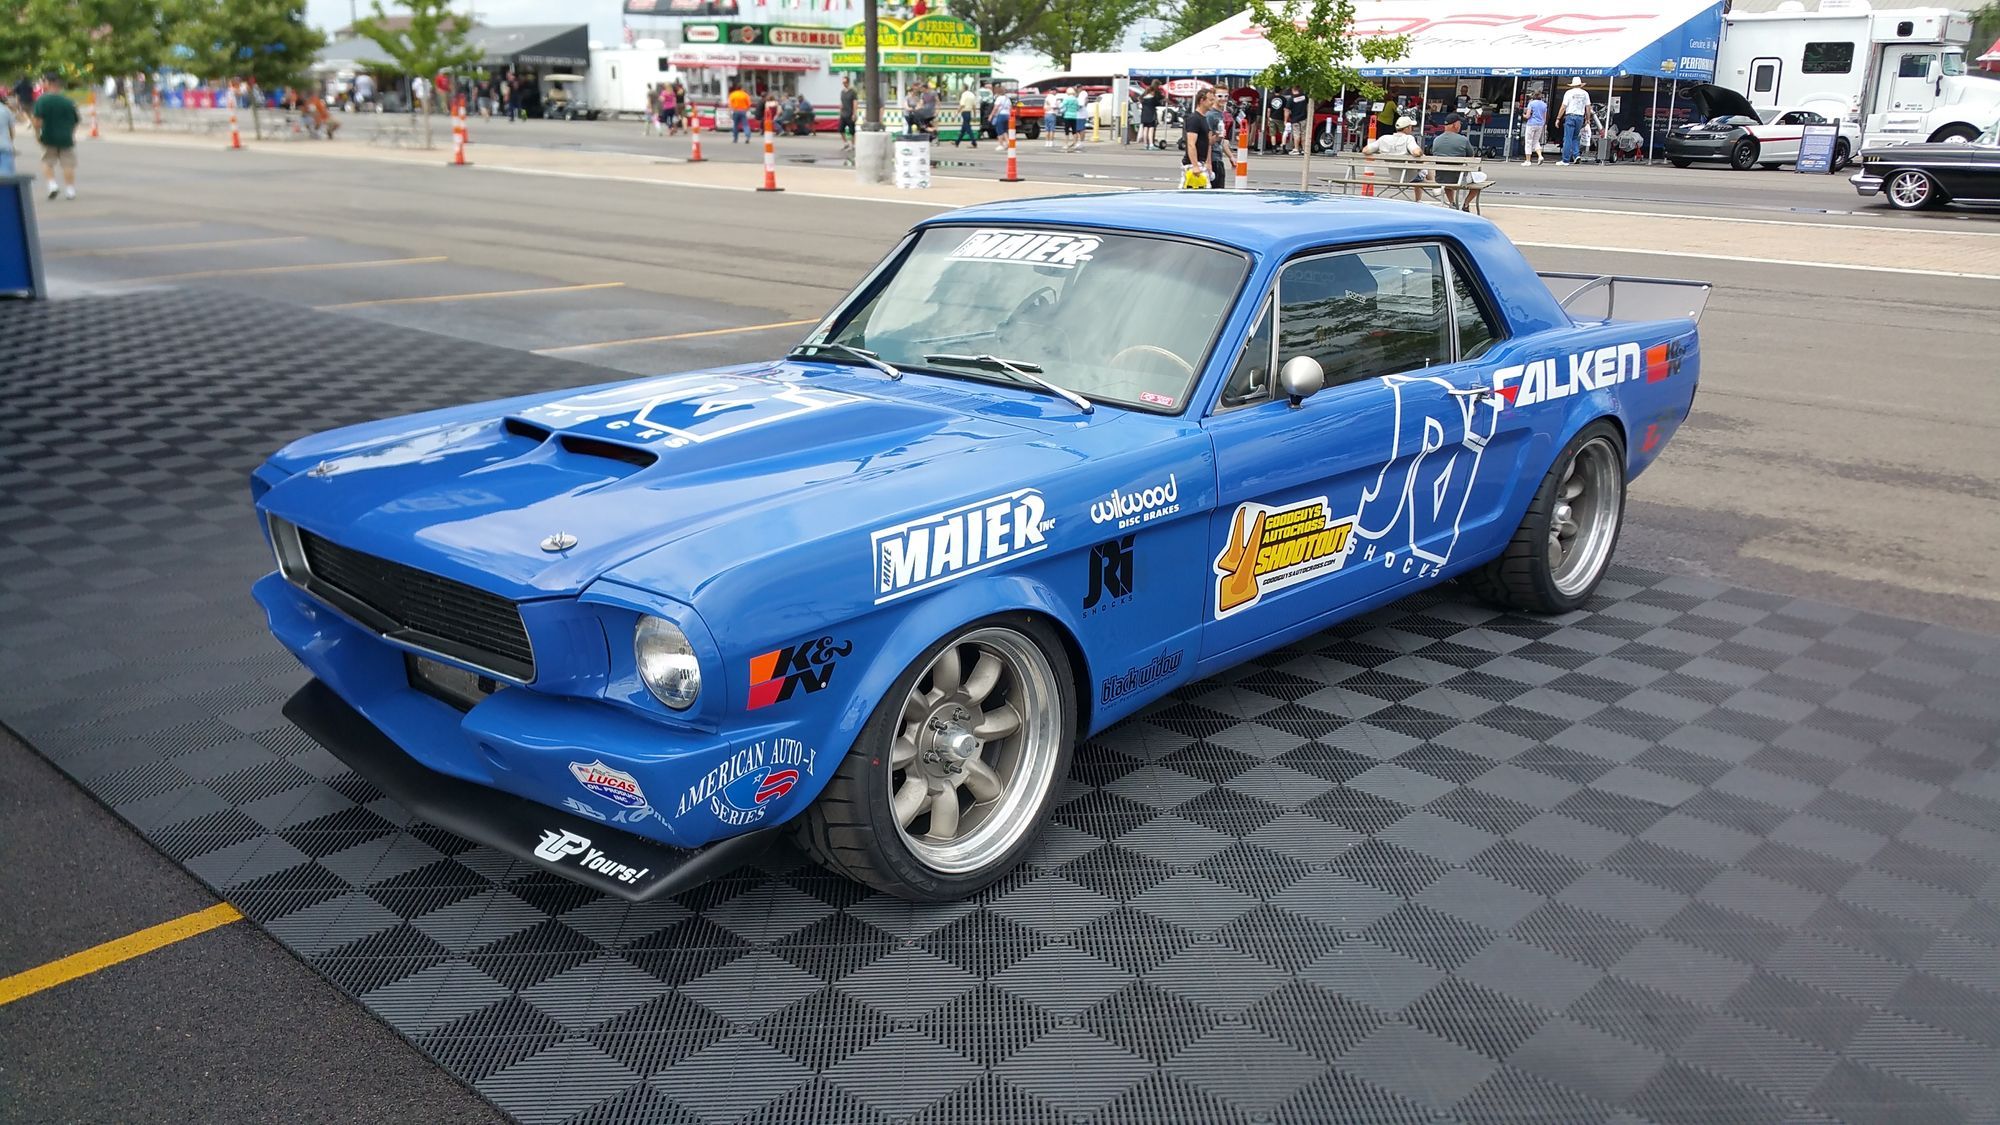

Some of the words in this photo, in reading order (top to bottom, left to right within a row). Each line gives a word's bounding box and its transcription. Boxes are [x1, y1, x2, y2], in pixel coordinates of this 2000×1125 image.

[775, 30, 843, 46] STROMBOL
[846, 34, 898, 47] LEMADE
[905, 31, 975, 47] LEMONADE
[926, 21, 956, 32] FRESH
[1689, 38, 1706, 49] Genuine
[946, 56, 990, 65] LEMONADE
[950, 232, 1101, 266] MAIER
[1492, 341, 1641, 412] FALKEN
[1090, 473, 1178, 525] wilwood
[1039, 517, 1056, 533] INC
[1118, 513, 1141, 530] DISC
[1143, 503, 1180, 523] BRAKES
[1262, 516, 1326, 545] AUTOCROSS
[1265, 504, 1322, 531] GOODGUYS
[880, 493, 1046, 592] MAIER
[1255, 523, 1353, 575] SHOOTOUT
[882, 545, 893, 588] MIKE
[1262, 558, 1336, 586] GOODGUYSAUTOCROSS.COM
[1347, 537, 1440, 579] SHOCKS
[1082, 594, 1134, 620] SHOCKS
[1101, 667, 1138, 704] black
[1138, 647, 1184, 688] widow
[588, 773, 636, 793] LUCAS
[674, 740, 766, 819] AMERICAN
[770, 737, 817, 777] AUTO-X
[710, 795, 767, 826] SERIES
[579, 847, 650, 885] Yours!
